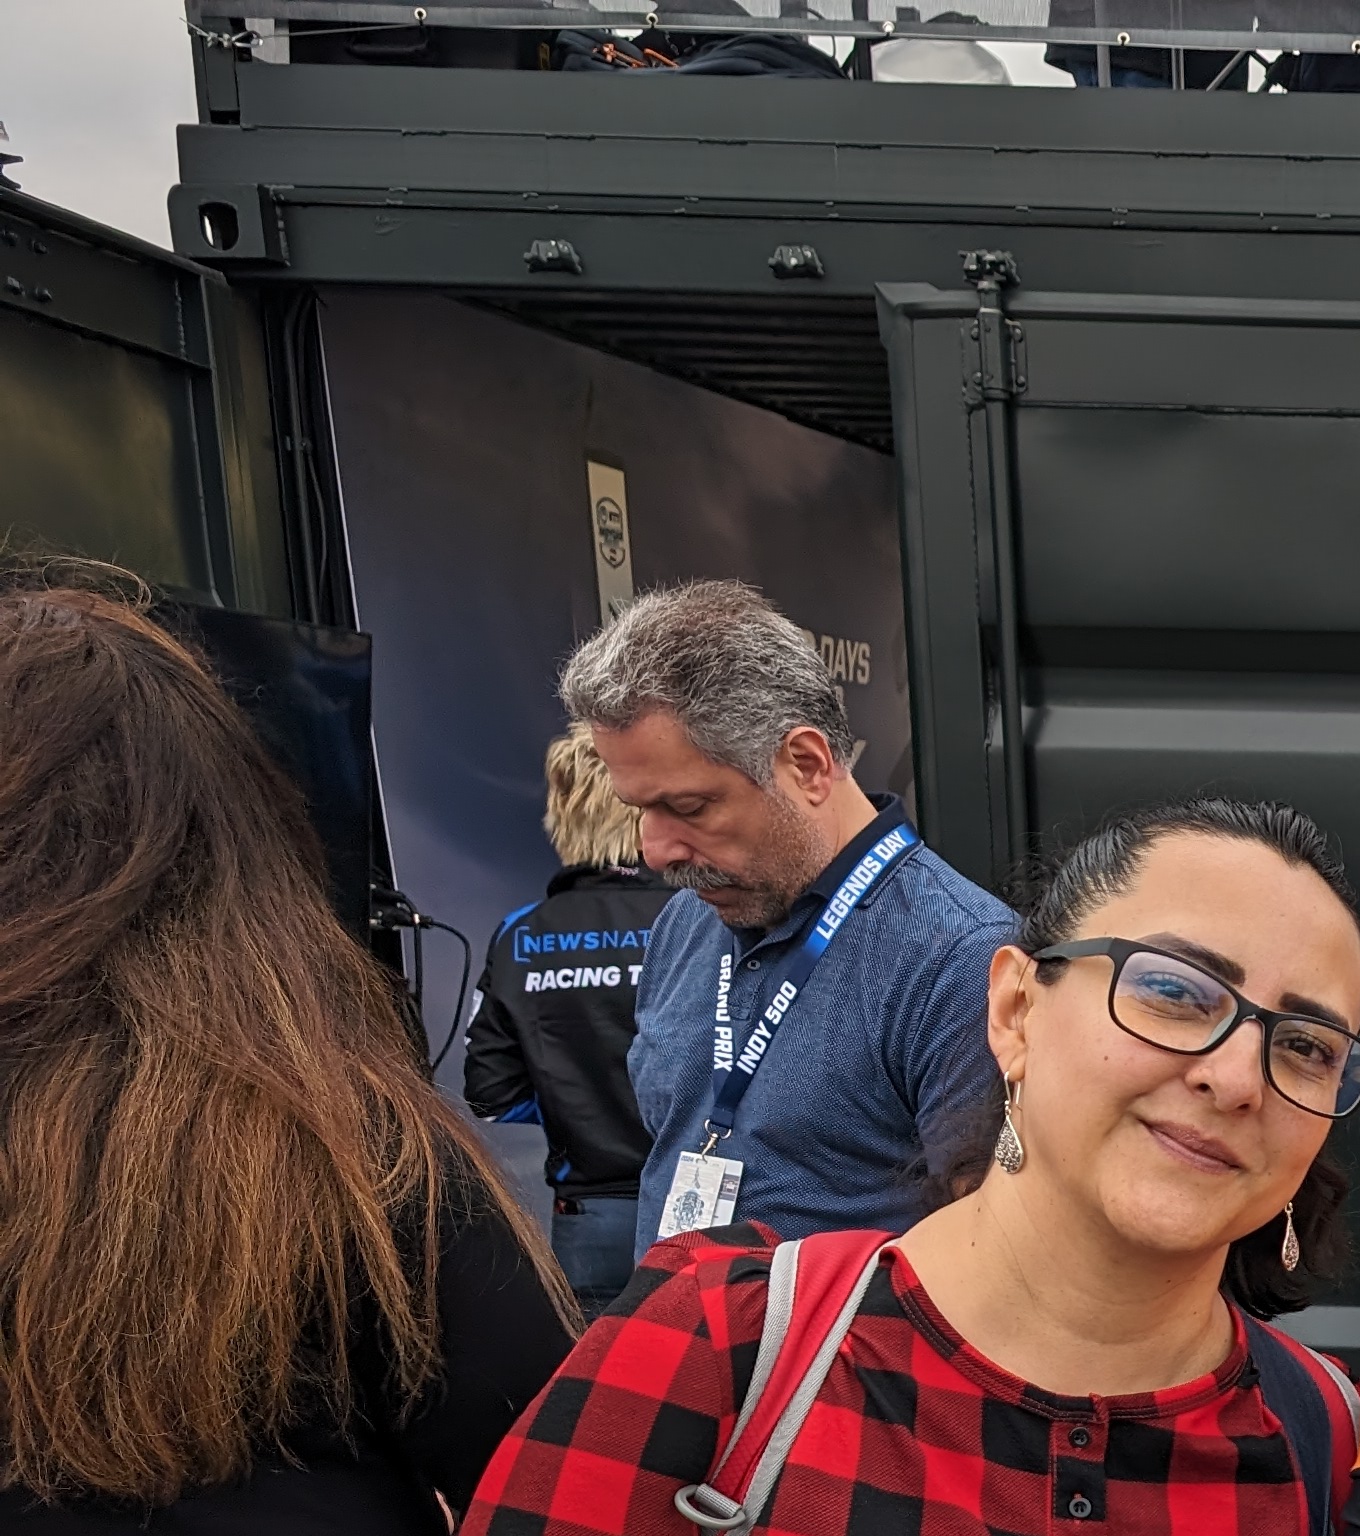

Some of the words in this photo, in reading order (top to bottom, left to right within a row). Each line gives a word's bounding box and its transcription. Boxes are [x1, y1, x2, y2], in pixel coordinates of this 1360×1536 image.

[815, 856, 883, 941] LEGENDS
[874, 830, 908, 861] DAY
[524, 965, 622, 993] RACING
[713, 1027, 734, 1073] PRIX
[736, 1020, 773, 1076] INDY
[764, 979, 798, 1026] 500
